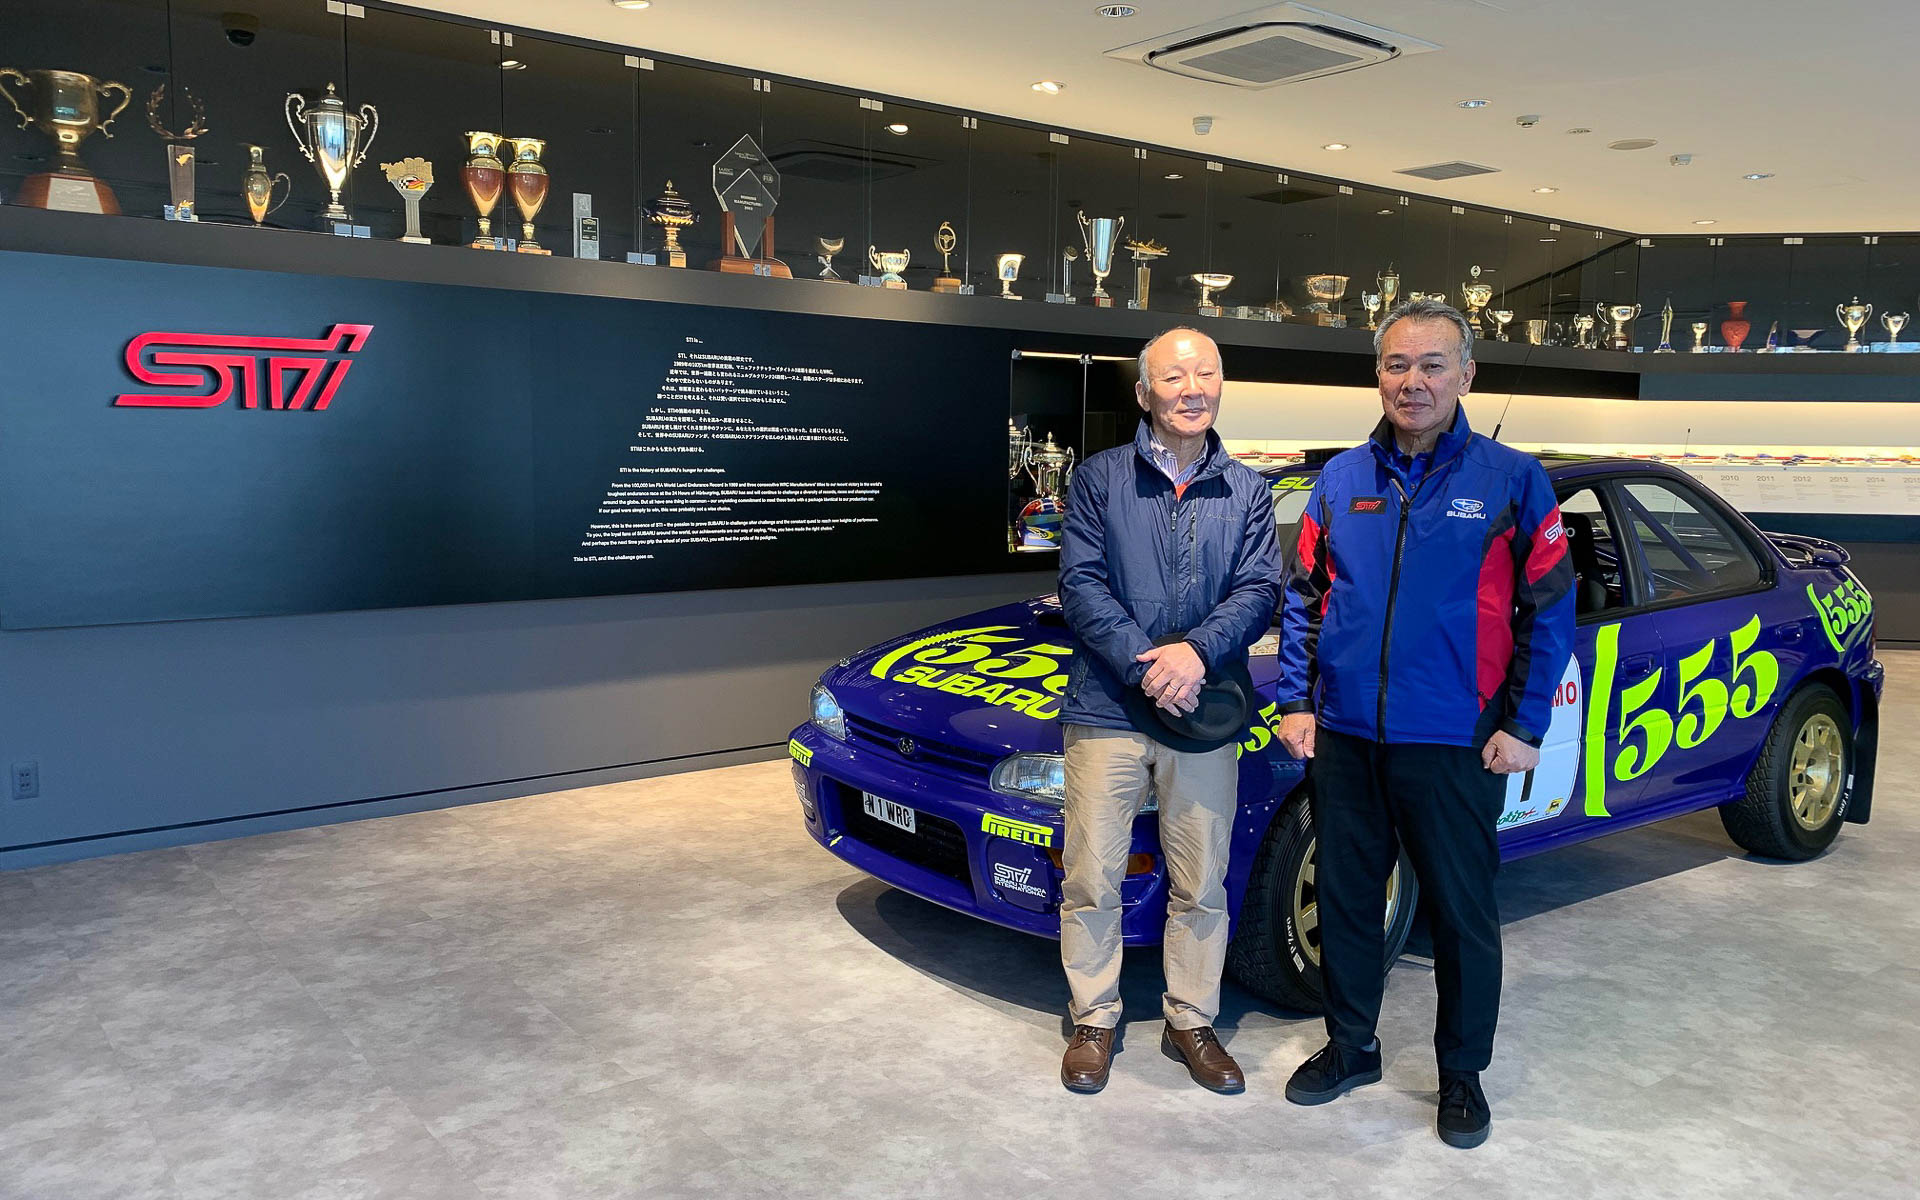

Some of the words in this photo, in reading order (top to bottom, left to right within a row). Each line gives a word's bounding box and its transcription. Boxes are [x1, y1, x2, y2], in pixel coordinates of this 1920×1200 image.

[1446, 511, 1486, 520] SUBARU
[1821, 578, 1872, 634] 555
[892, 666, 1060, 720] SUBARU
[1614, 614, 1778, 781] 555
[886, 801, 910, 828] WRC
[981, 812, 1054, 848] PIRELLI
[994, 876, 1017, 886] SUBARU
[1018, 883, 1046, 894] TECNICA
[994, 880, 1046, 898] INTERNATIONAL
